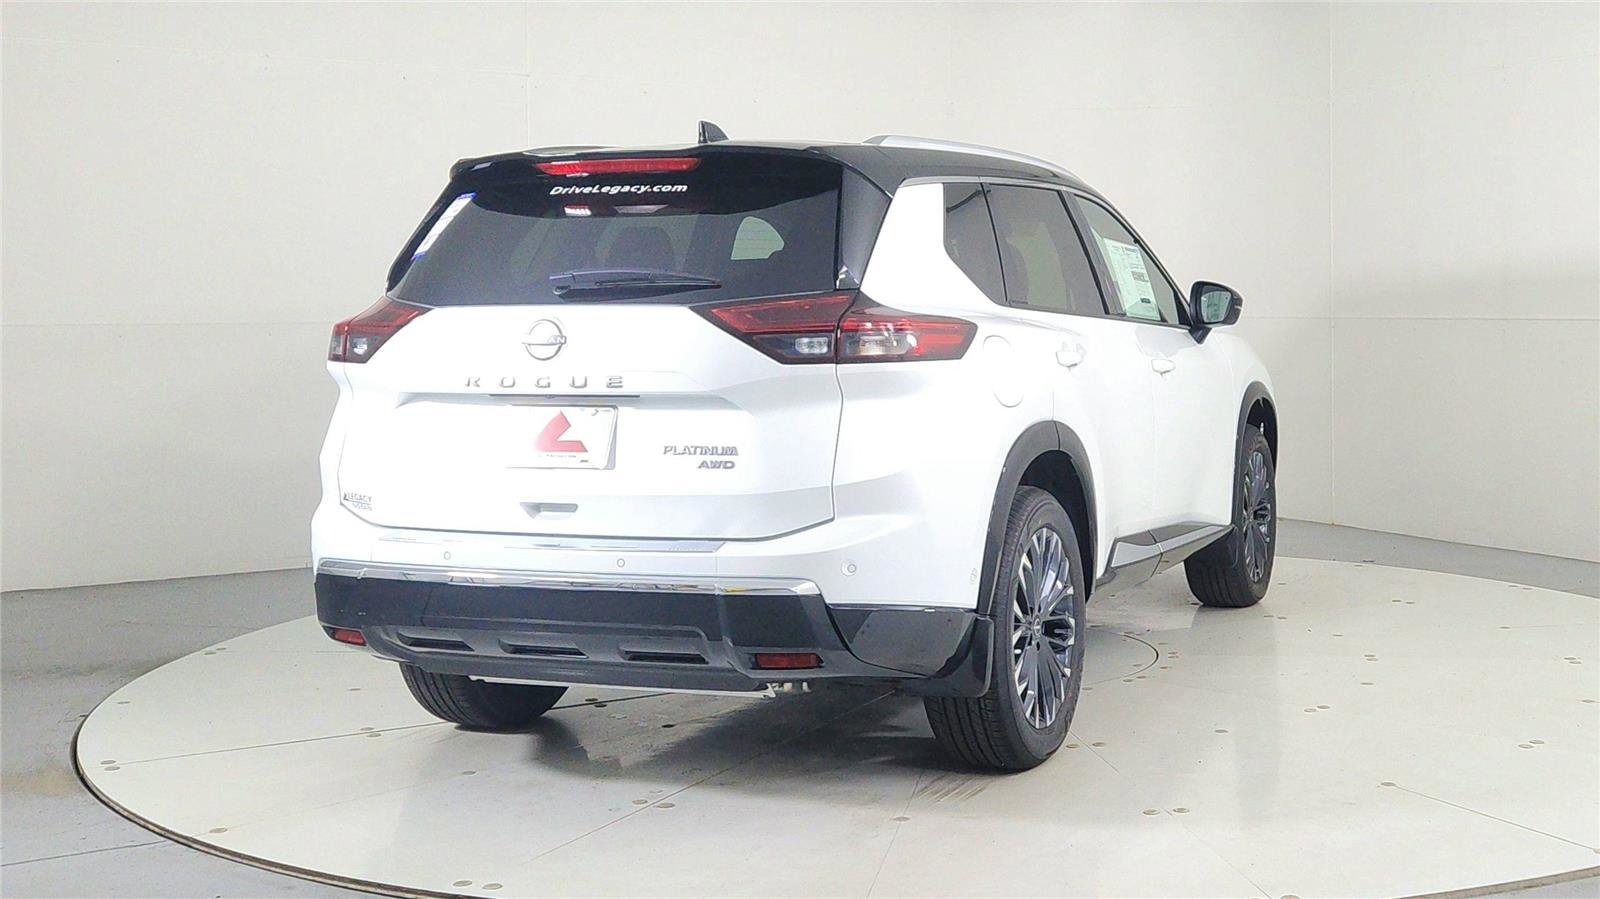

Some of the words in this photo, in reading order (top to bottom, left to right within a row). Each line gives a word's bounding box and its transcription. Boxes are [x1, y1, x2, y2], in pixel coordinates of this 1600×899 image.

[549, 184, 688, 195] DriveLegacy.com
[465, 375, 624, 389] ROGUE
[663, 445, 738, 456] PLATINUM
[696, 460, 736, 470] AWD
